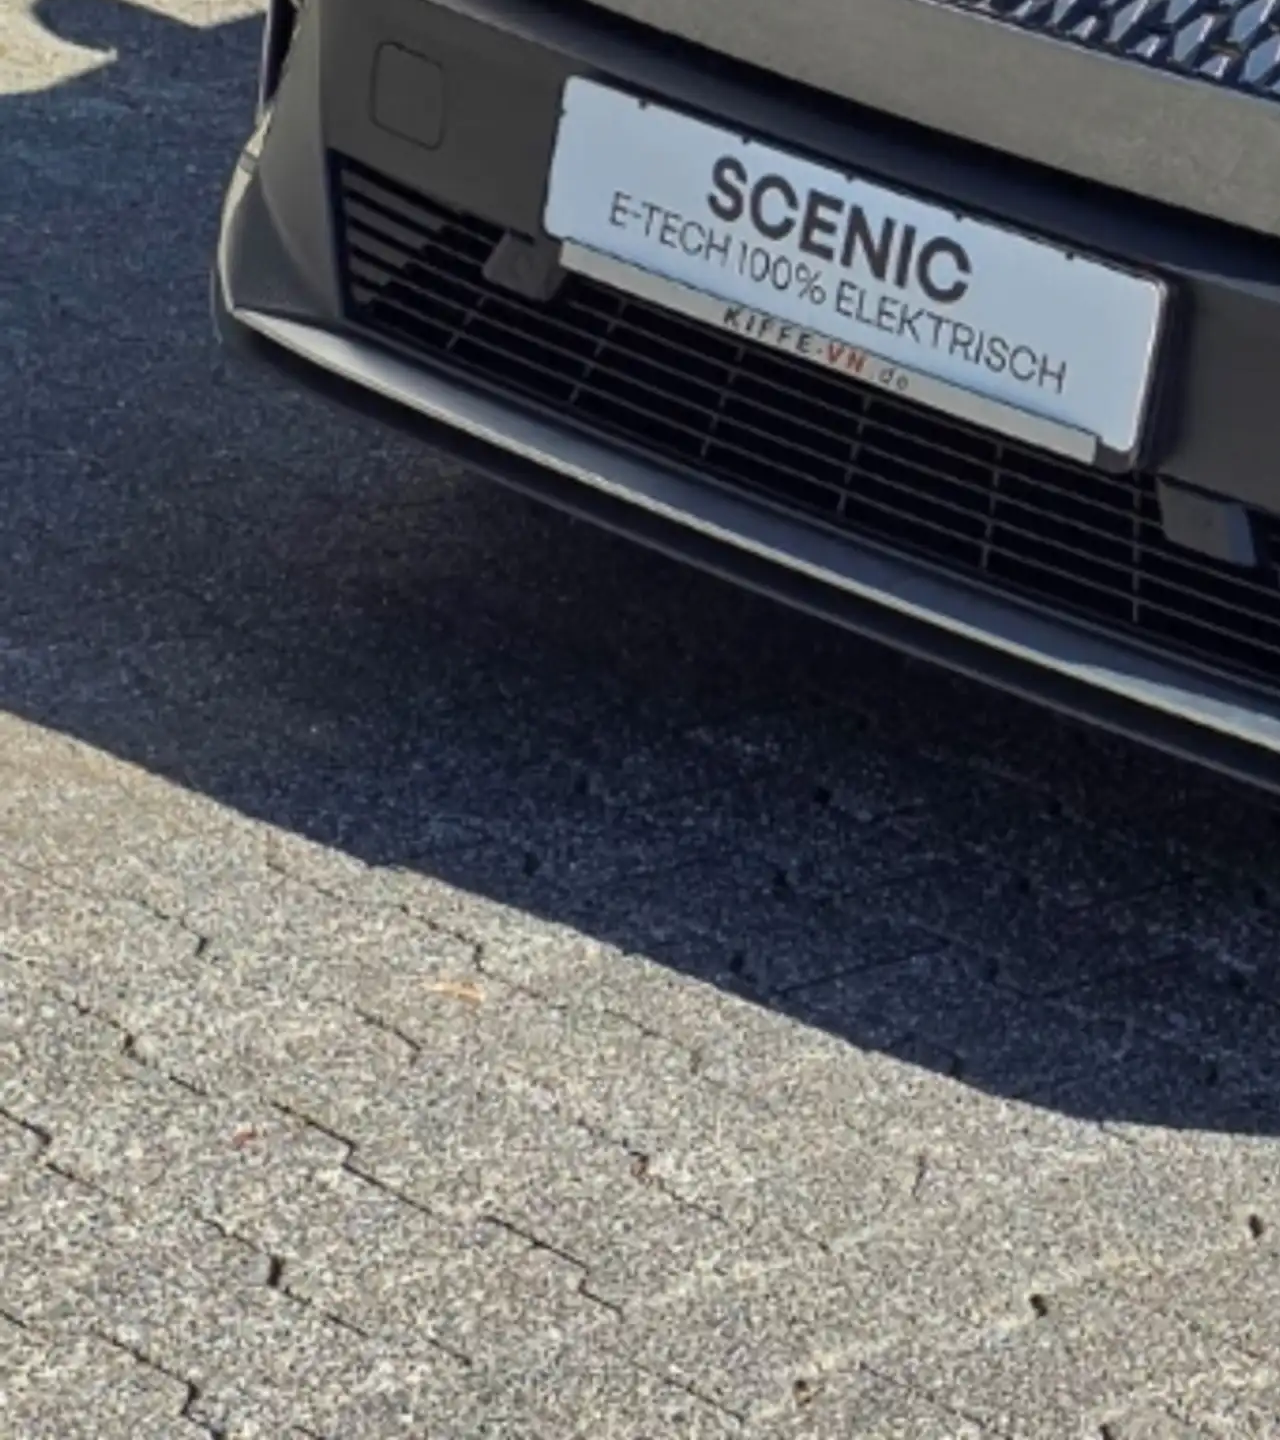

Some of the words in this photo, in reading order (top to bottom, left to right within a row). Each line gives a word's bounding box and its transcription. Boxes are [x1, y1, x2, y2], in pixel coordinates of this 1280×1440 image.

[609, 190, 731, 268] E-TECH
[737, 240, 826, 306] 100%
[835, 269, 1067, 395] ELEKTRISCH
[707, 155, 972, 303] SCENIC
